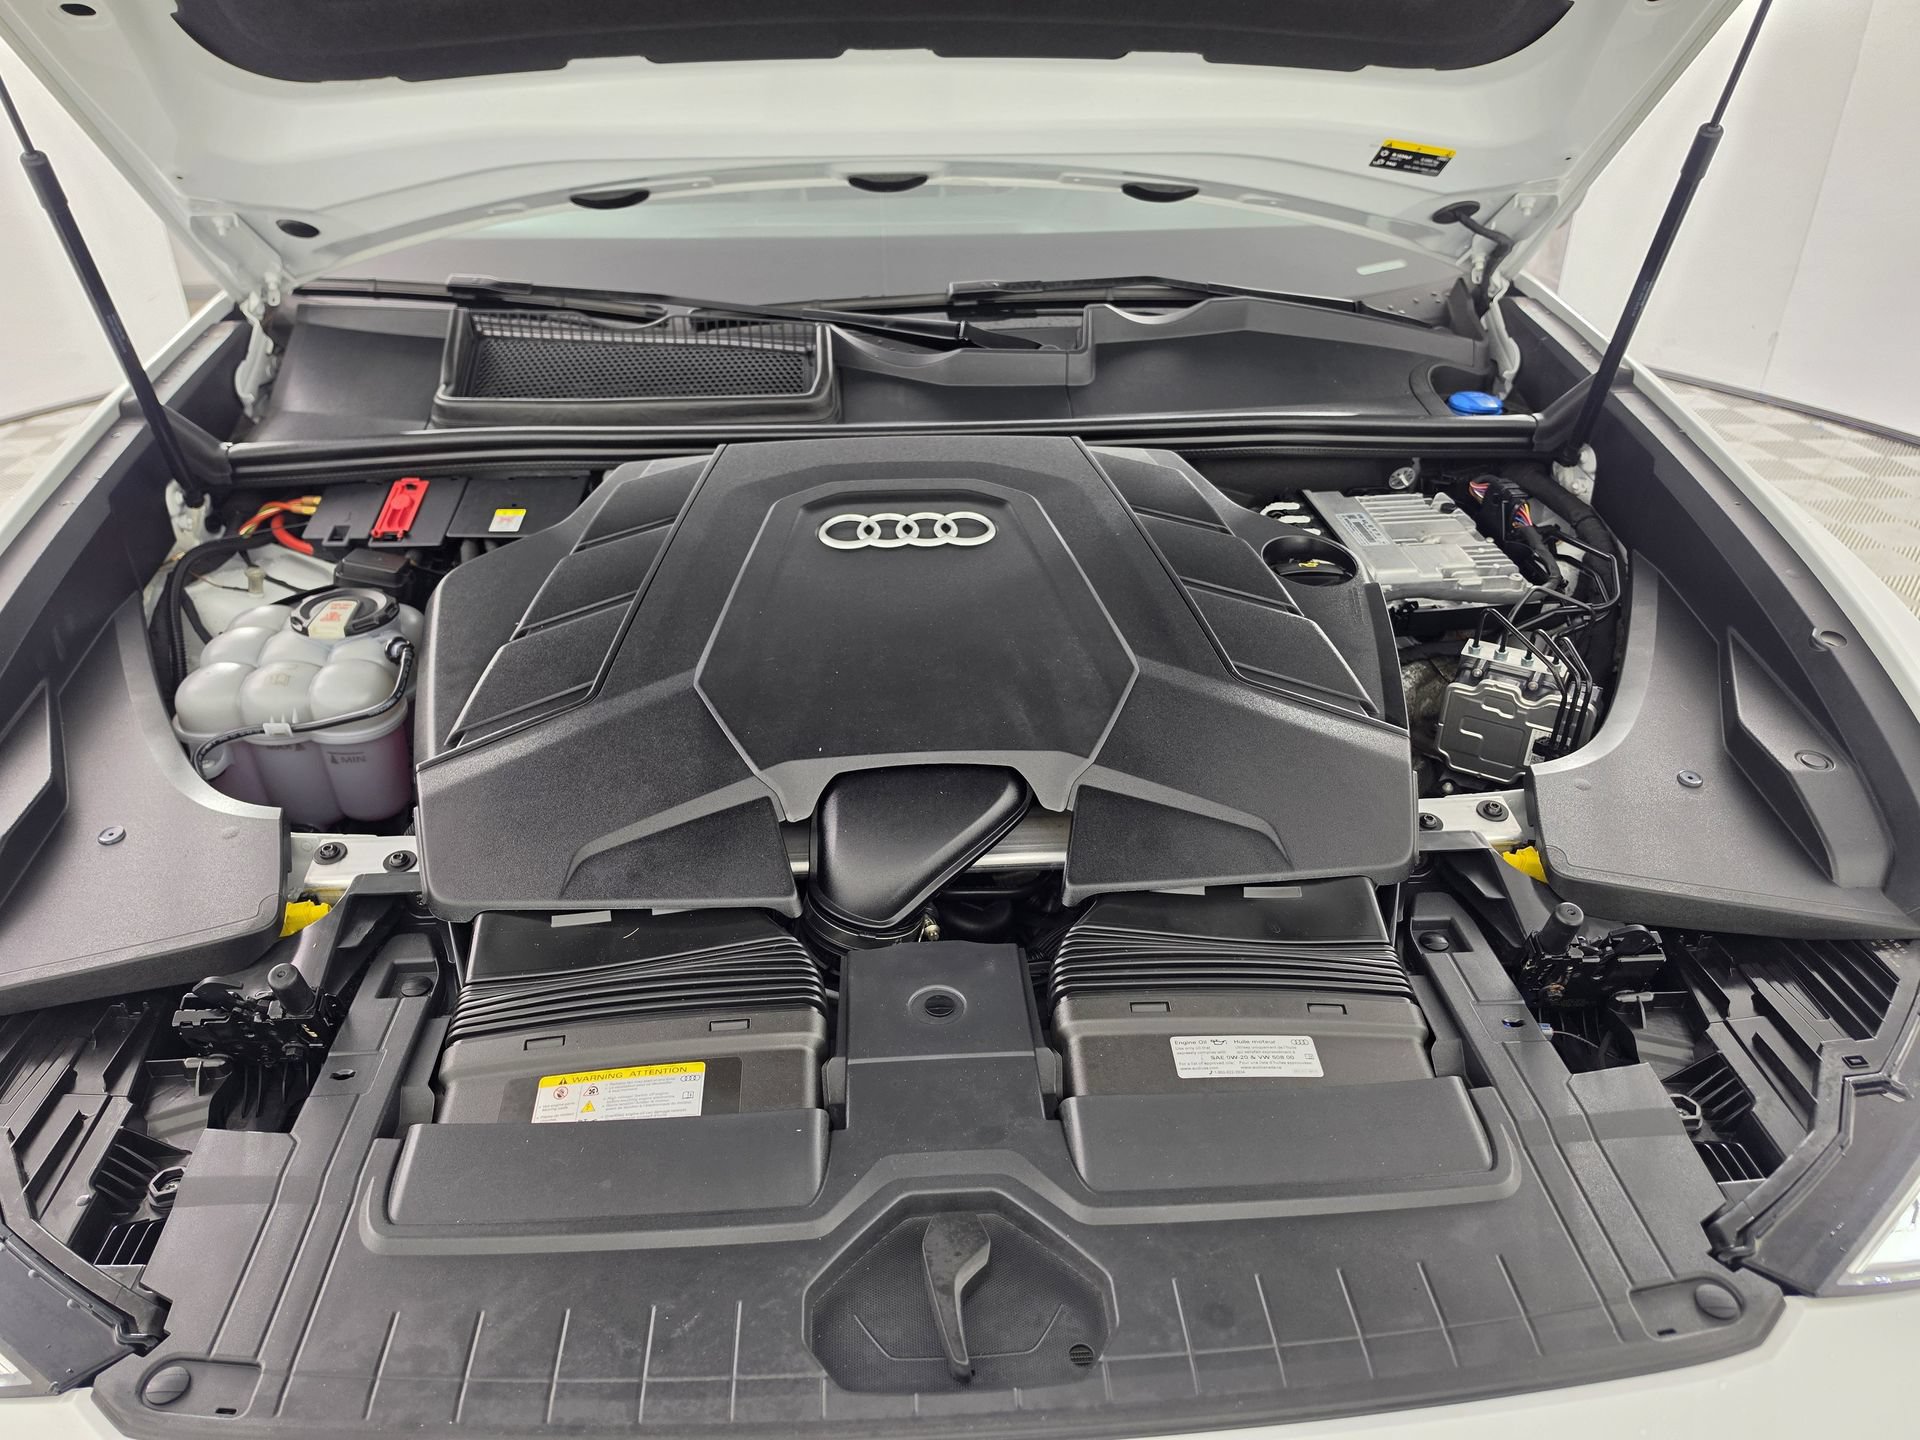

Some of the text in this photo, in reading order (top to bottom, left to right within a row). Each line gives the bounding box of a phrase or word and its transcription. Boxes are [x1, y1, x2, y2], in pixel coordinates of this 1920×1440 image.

[340, 755, 367, 764] MIN
[572, 1066, 688, 1083] WARNING ATTENTION
